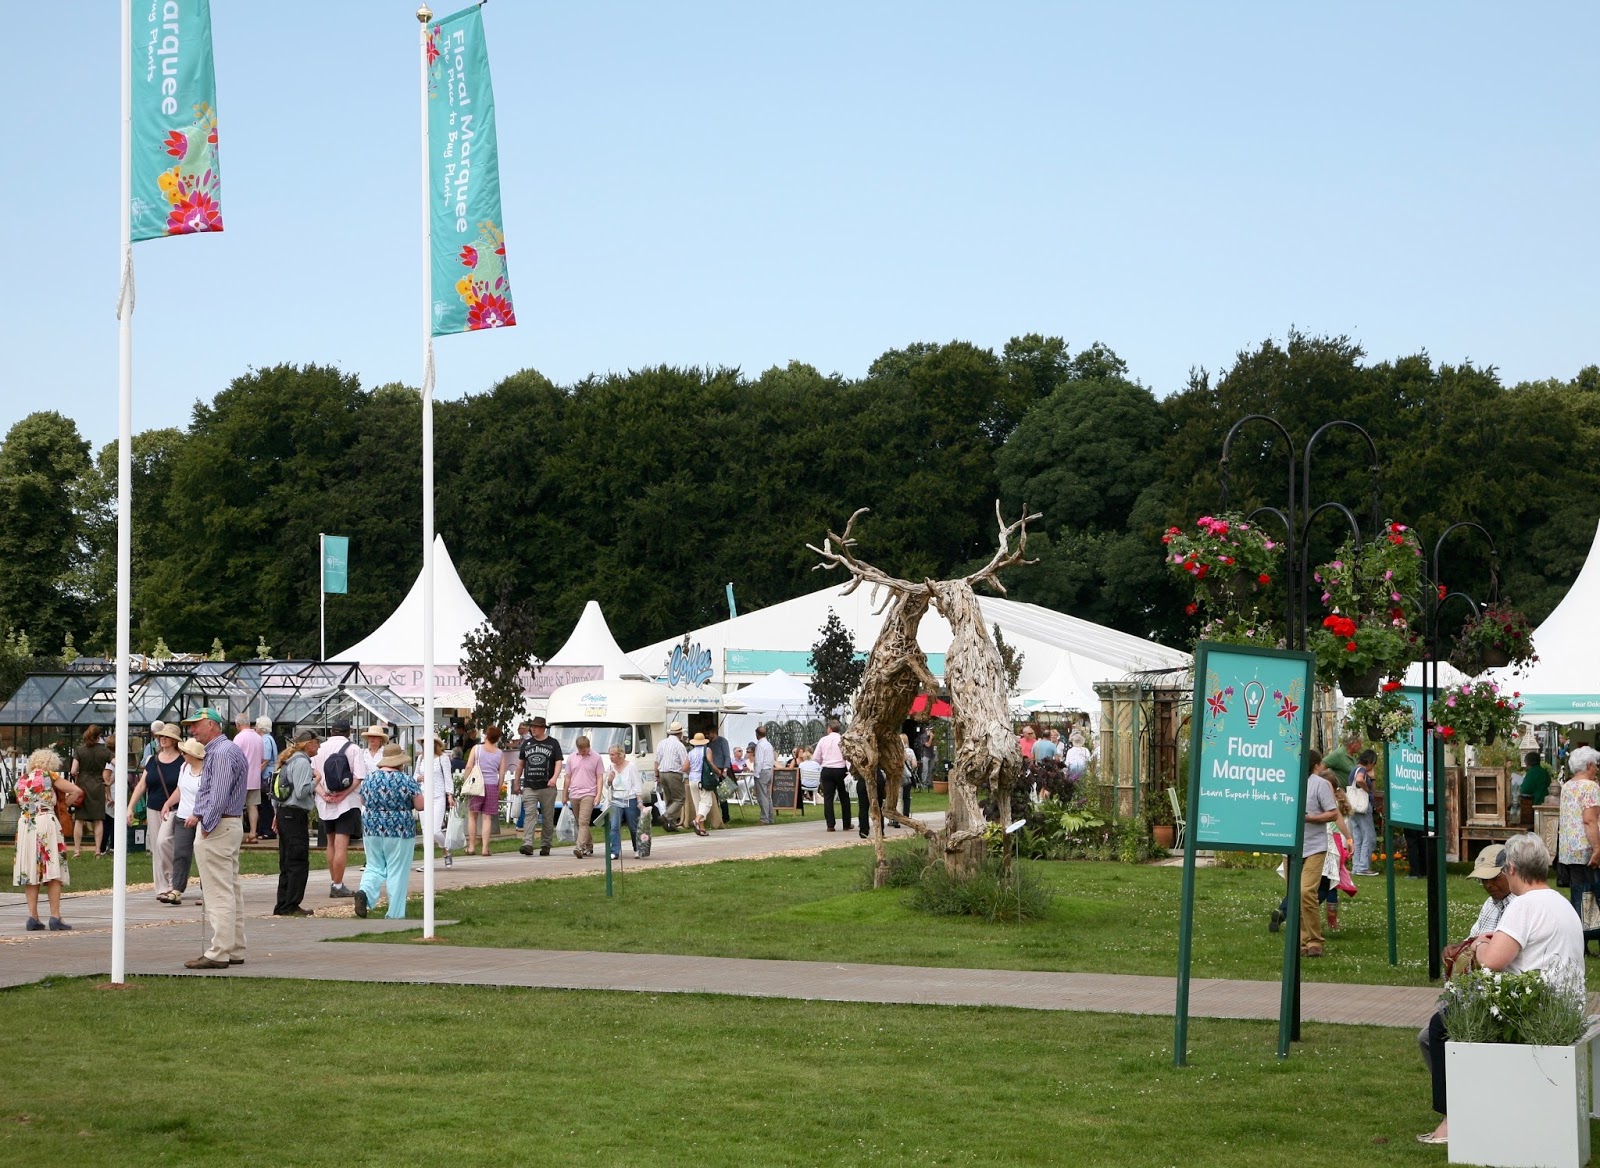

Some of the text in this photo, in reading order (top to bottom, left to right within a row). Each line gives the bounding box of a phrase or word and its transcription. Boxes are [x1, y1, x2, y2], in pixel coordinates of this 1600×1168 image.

[147, 0, 158, 82] uy Plants
[157, 0, 179, 115] arquee
[447, 68, 455, 107] Place
[449, 111, 457, 125] to
[453, 29, 474, 233] Floral Marquee
[444, 130, 458, 158] Buy
[388, 670, 407, 687] &
[669, 643, 713, 688] Coffee
[1228, 736, 1273, 759] Floral
[1212, 759, 1286, 786] Marquee
[1200, 787, 1223, 798] Learn
[1225, 788, 1250, 802] Expert
[1252, 788, 1271, 801] Hints
[1279, 792, 1295, 804] Tips
